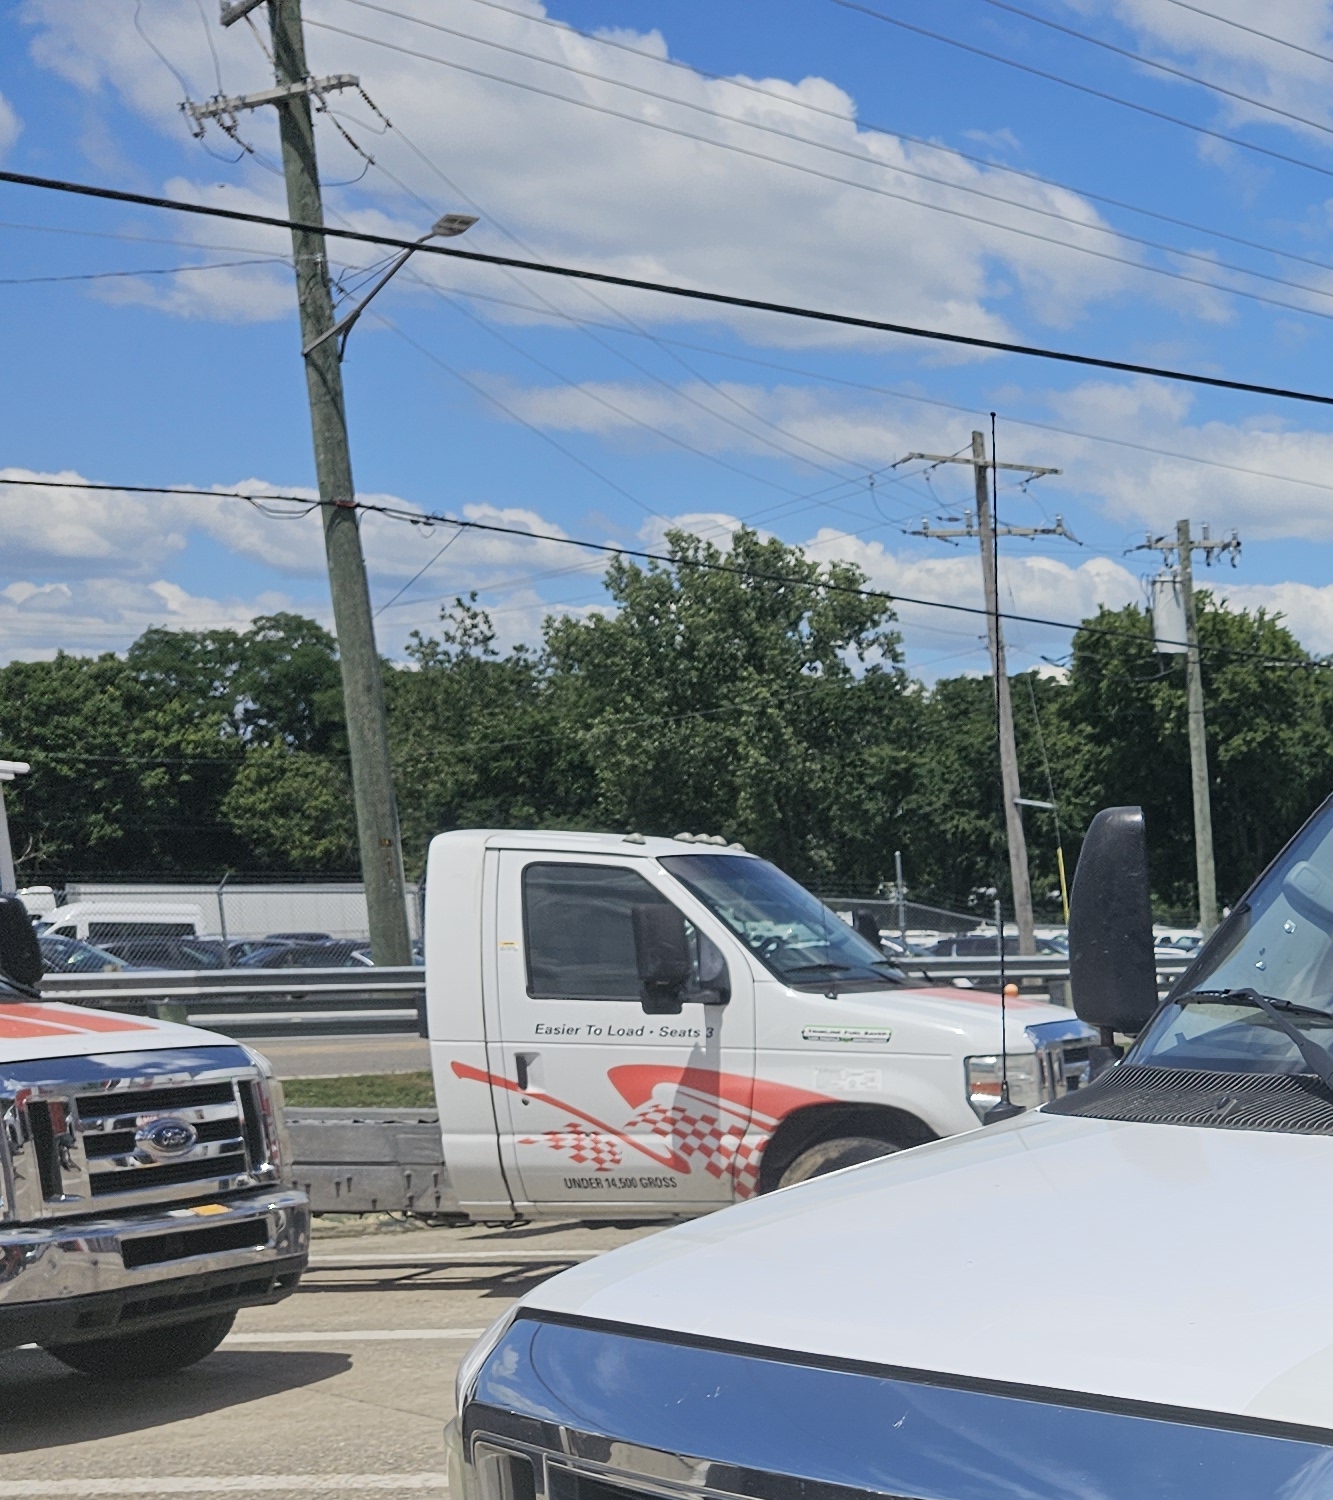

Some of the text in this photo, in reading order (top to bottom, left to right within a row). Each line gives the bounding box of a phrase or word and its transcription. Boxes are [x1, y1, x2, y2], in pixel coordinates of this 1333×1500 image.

[535, 1023, 714, 1038] Easier To Load Seats 3
[564, 1177, 603, 1189] UNDER
[640, 1177, 677, 1188] GROSS
